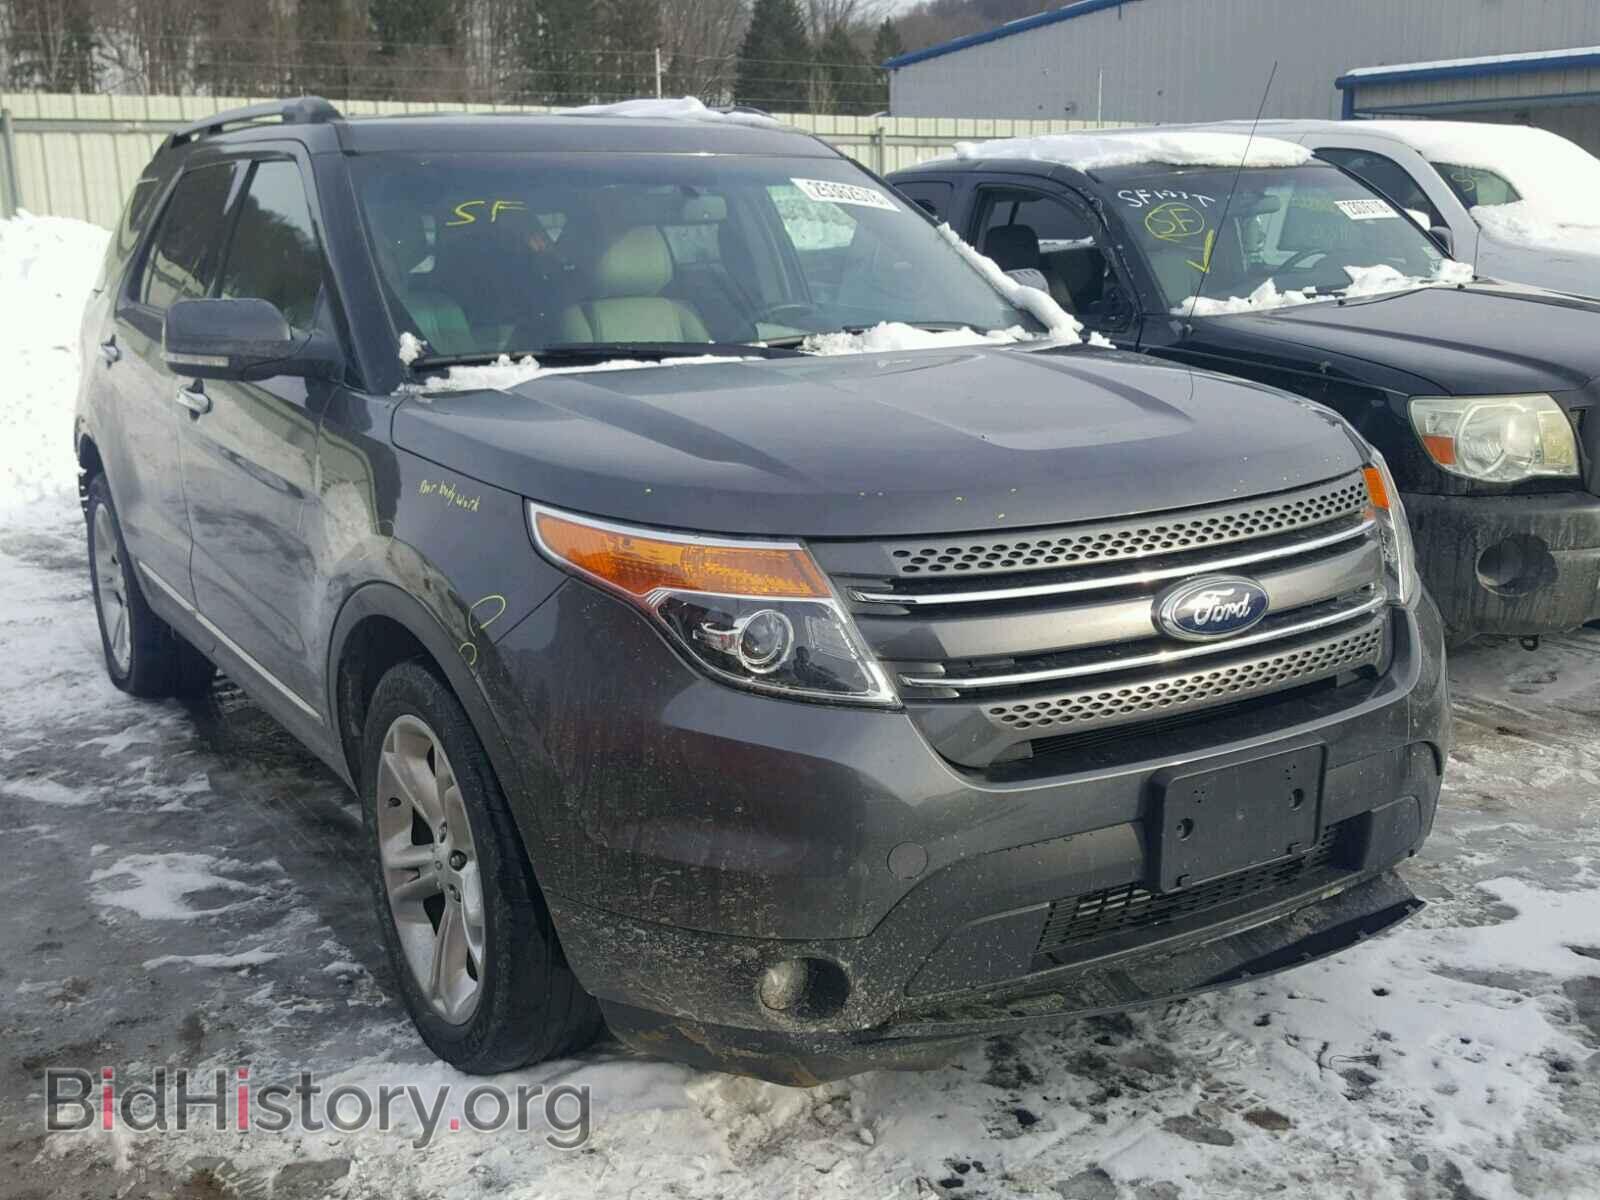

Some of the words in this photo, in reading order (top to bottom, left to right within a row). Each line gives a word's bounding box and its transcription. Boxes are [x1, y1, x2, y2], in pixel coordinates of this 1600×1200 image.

[445, 200, 527, 226] SF
[1147, 207, 1196, 234] SF
[1184, 588, 1251, 625] Ford
